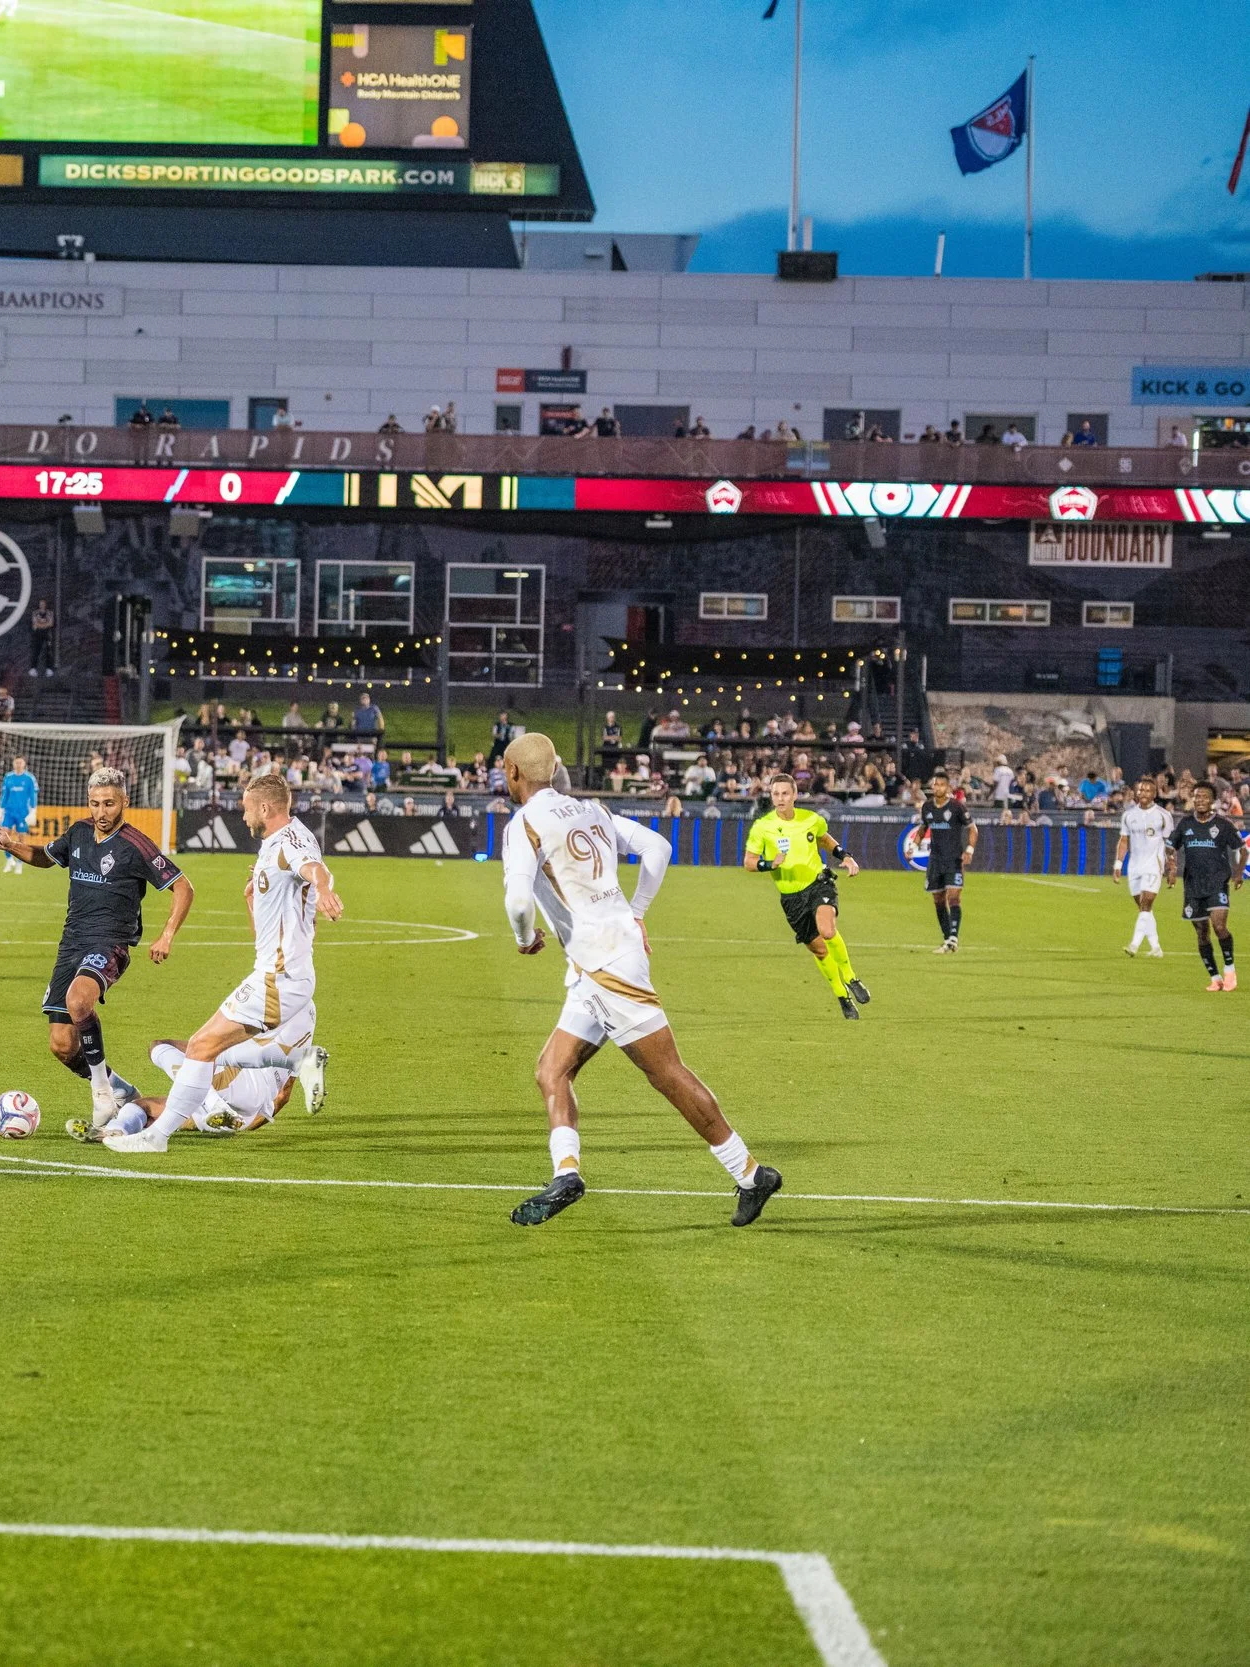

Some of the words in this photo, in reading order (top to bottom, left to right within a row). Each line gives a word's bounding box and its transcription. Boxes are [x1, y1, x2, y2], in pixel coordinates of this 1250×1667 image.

[356, 73, 388, 87] HCA
[389, 73, 461, 88] HealthONE
[65, 162, 455, 187] DICKSSPORTINGGOODSPARK.COM
[1141, 380, 1190, 395] KICK
[1196, 381, 1208, 396] &
[1214, 381, 1245, 396] GO
[154, 432, 395, 462] RAPIDS
[35, 470, 104, 496] 17:25
[219, 472, 242, 502] 0
[1064, 523, 1167, 563] BOUNDARY
[566, 823, 613, 881] 91
[603, 886, 623, 900] MEX
[234, 983, 255, 1004] 5
